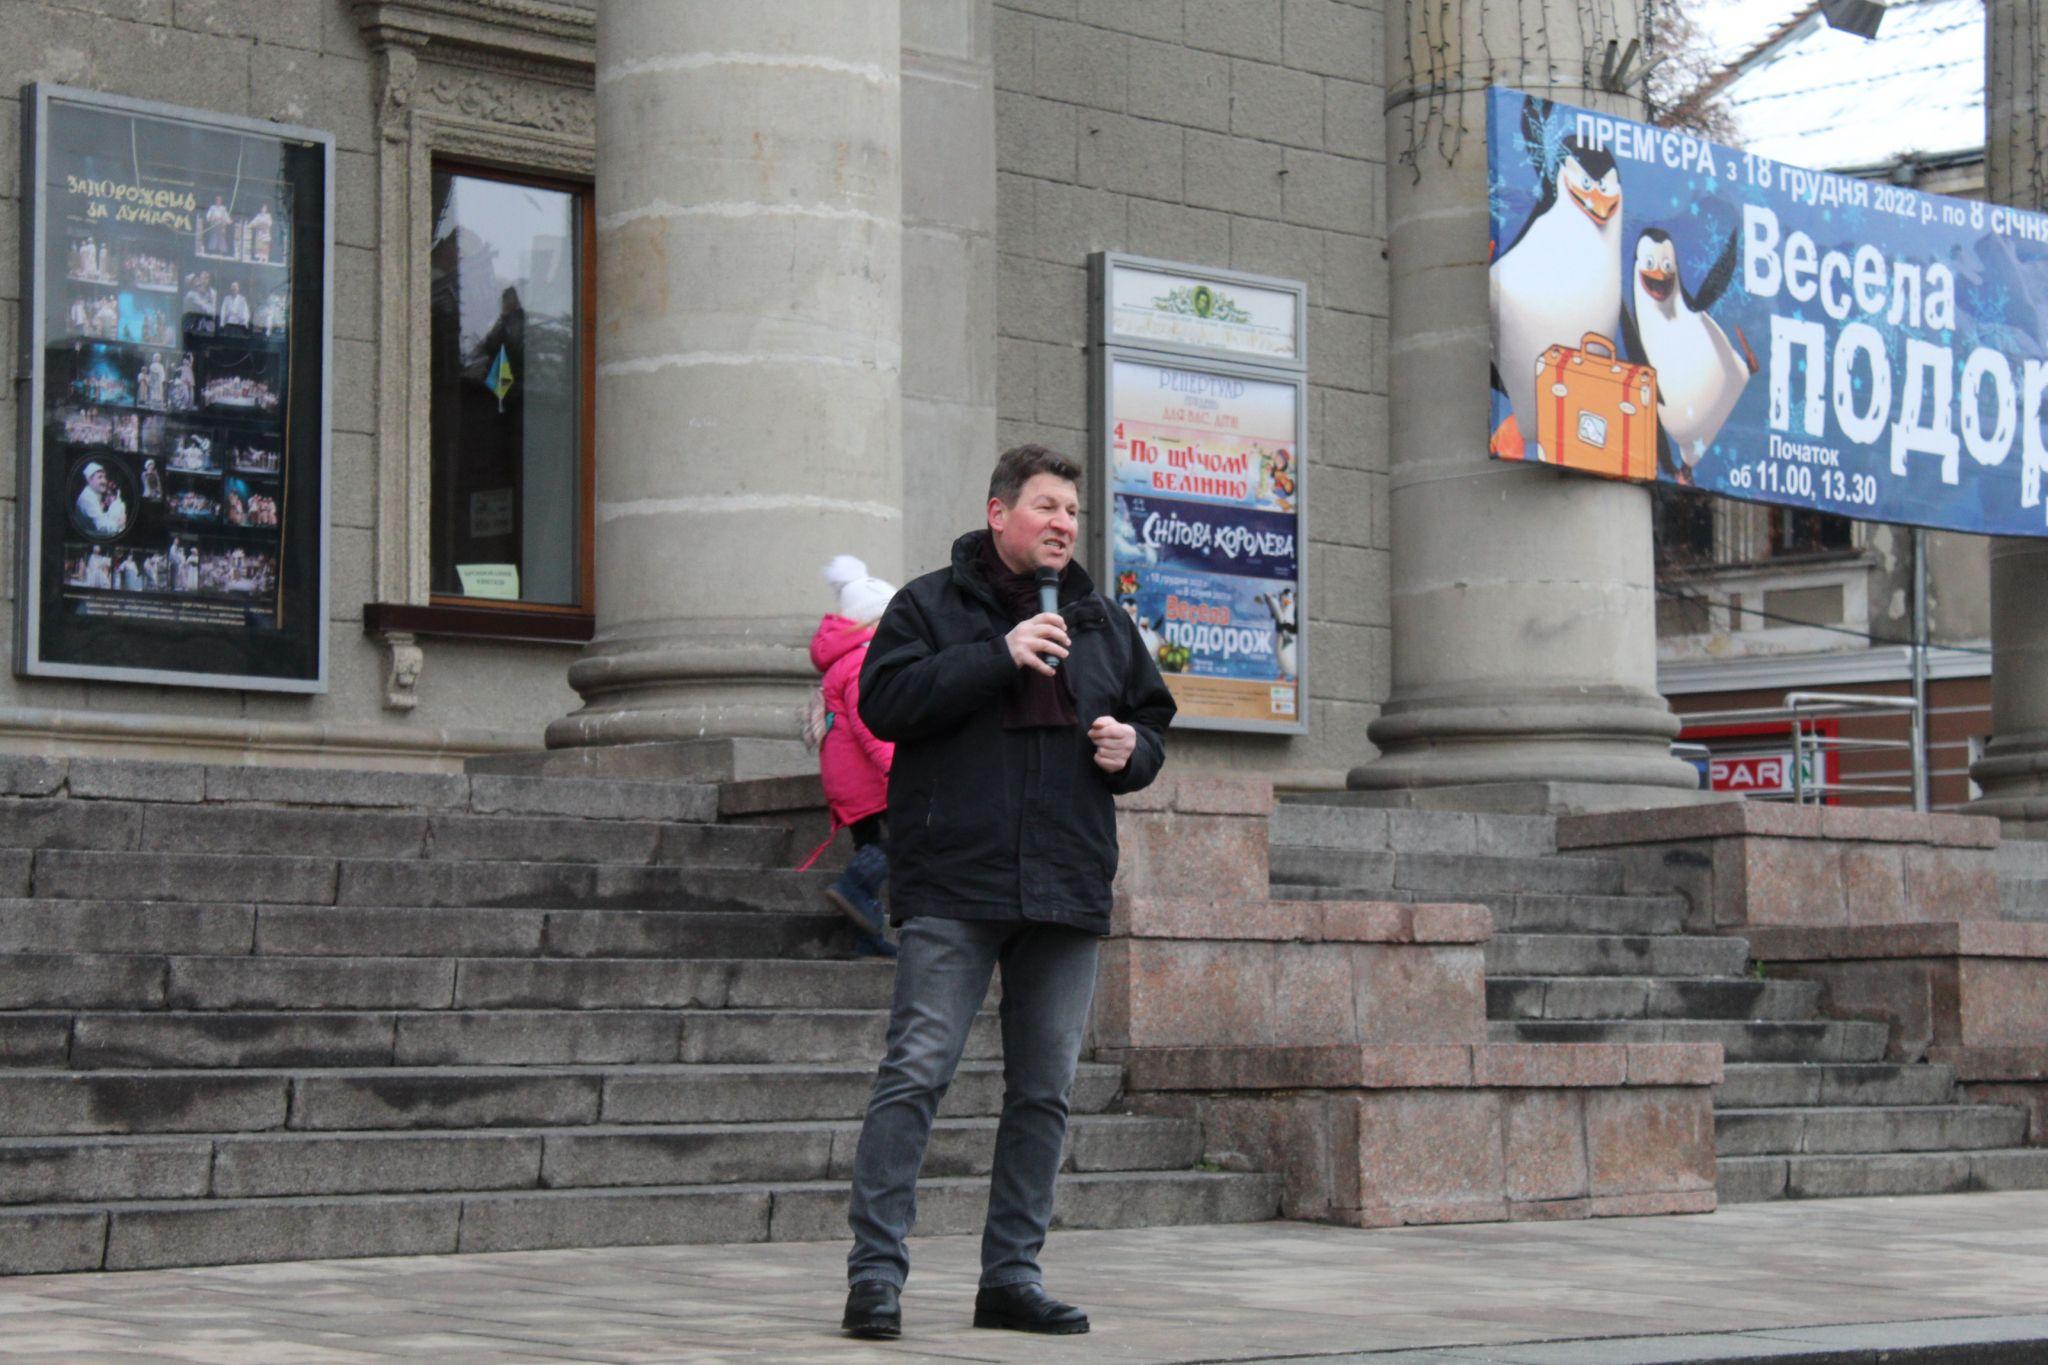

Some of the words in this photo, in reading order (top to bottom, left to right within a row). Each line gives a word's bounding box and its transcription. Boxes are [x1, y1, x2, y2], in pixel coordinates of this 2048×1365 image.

[1576, 113, 1716, 176] ПРЕМ'ЄРА
[1743, 151, 1773, 188] 18
[1780, 165, 1868, 208] грудня
[1873, 185, 1916, 217] 2022
[1921, 202, 1938, 225] р.
[1942, 204, 1966, 226] по
[1969, 201, 1985, 229] 8
[1743, 203, 1957, 332] Весела
[1114, 421, 1124, 440] 4
[1769, 434, 1840, 467] Початок
[1729, 464, 1752, 489] об
[1821, 469, 1877, 506] 13.30
[1166, 594, 1231, 626] Весела
[1712, 760, 1781, 787] PAR
